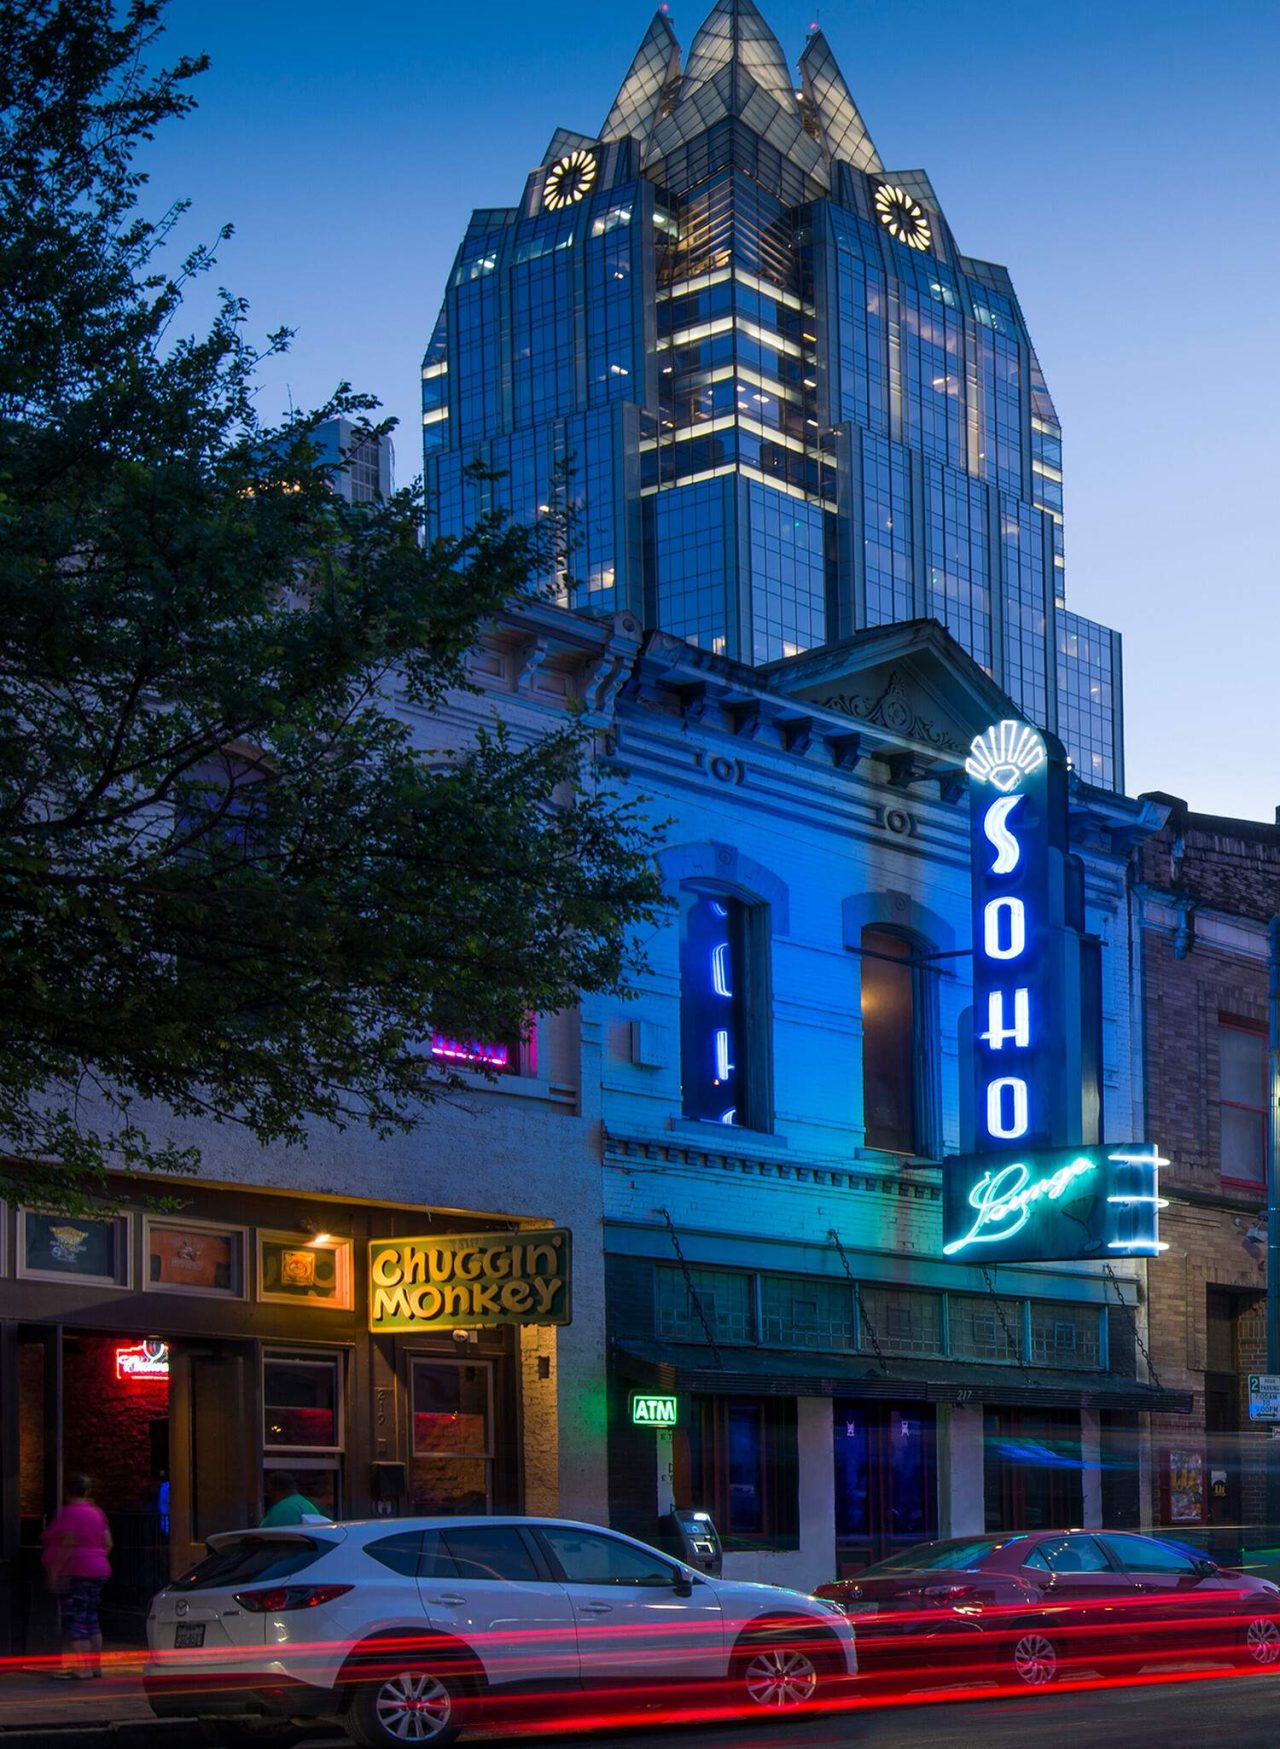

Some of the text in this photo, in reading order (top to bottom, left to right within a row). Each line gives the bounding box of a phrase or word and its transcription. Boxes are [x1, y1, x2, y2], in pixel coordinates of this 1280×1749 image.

[982, 793, 1030, 1141] SOHO
[942, 1154, 1096, 1256] Lounge
[956, 1389, 973, 1401] 217
[1251, 1378, 1259, 1391] 2
[635, 1400, 675, 1421] ATM
